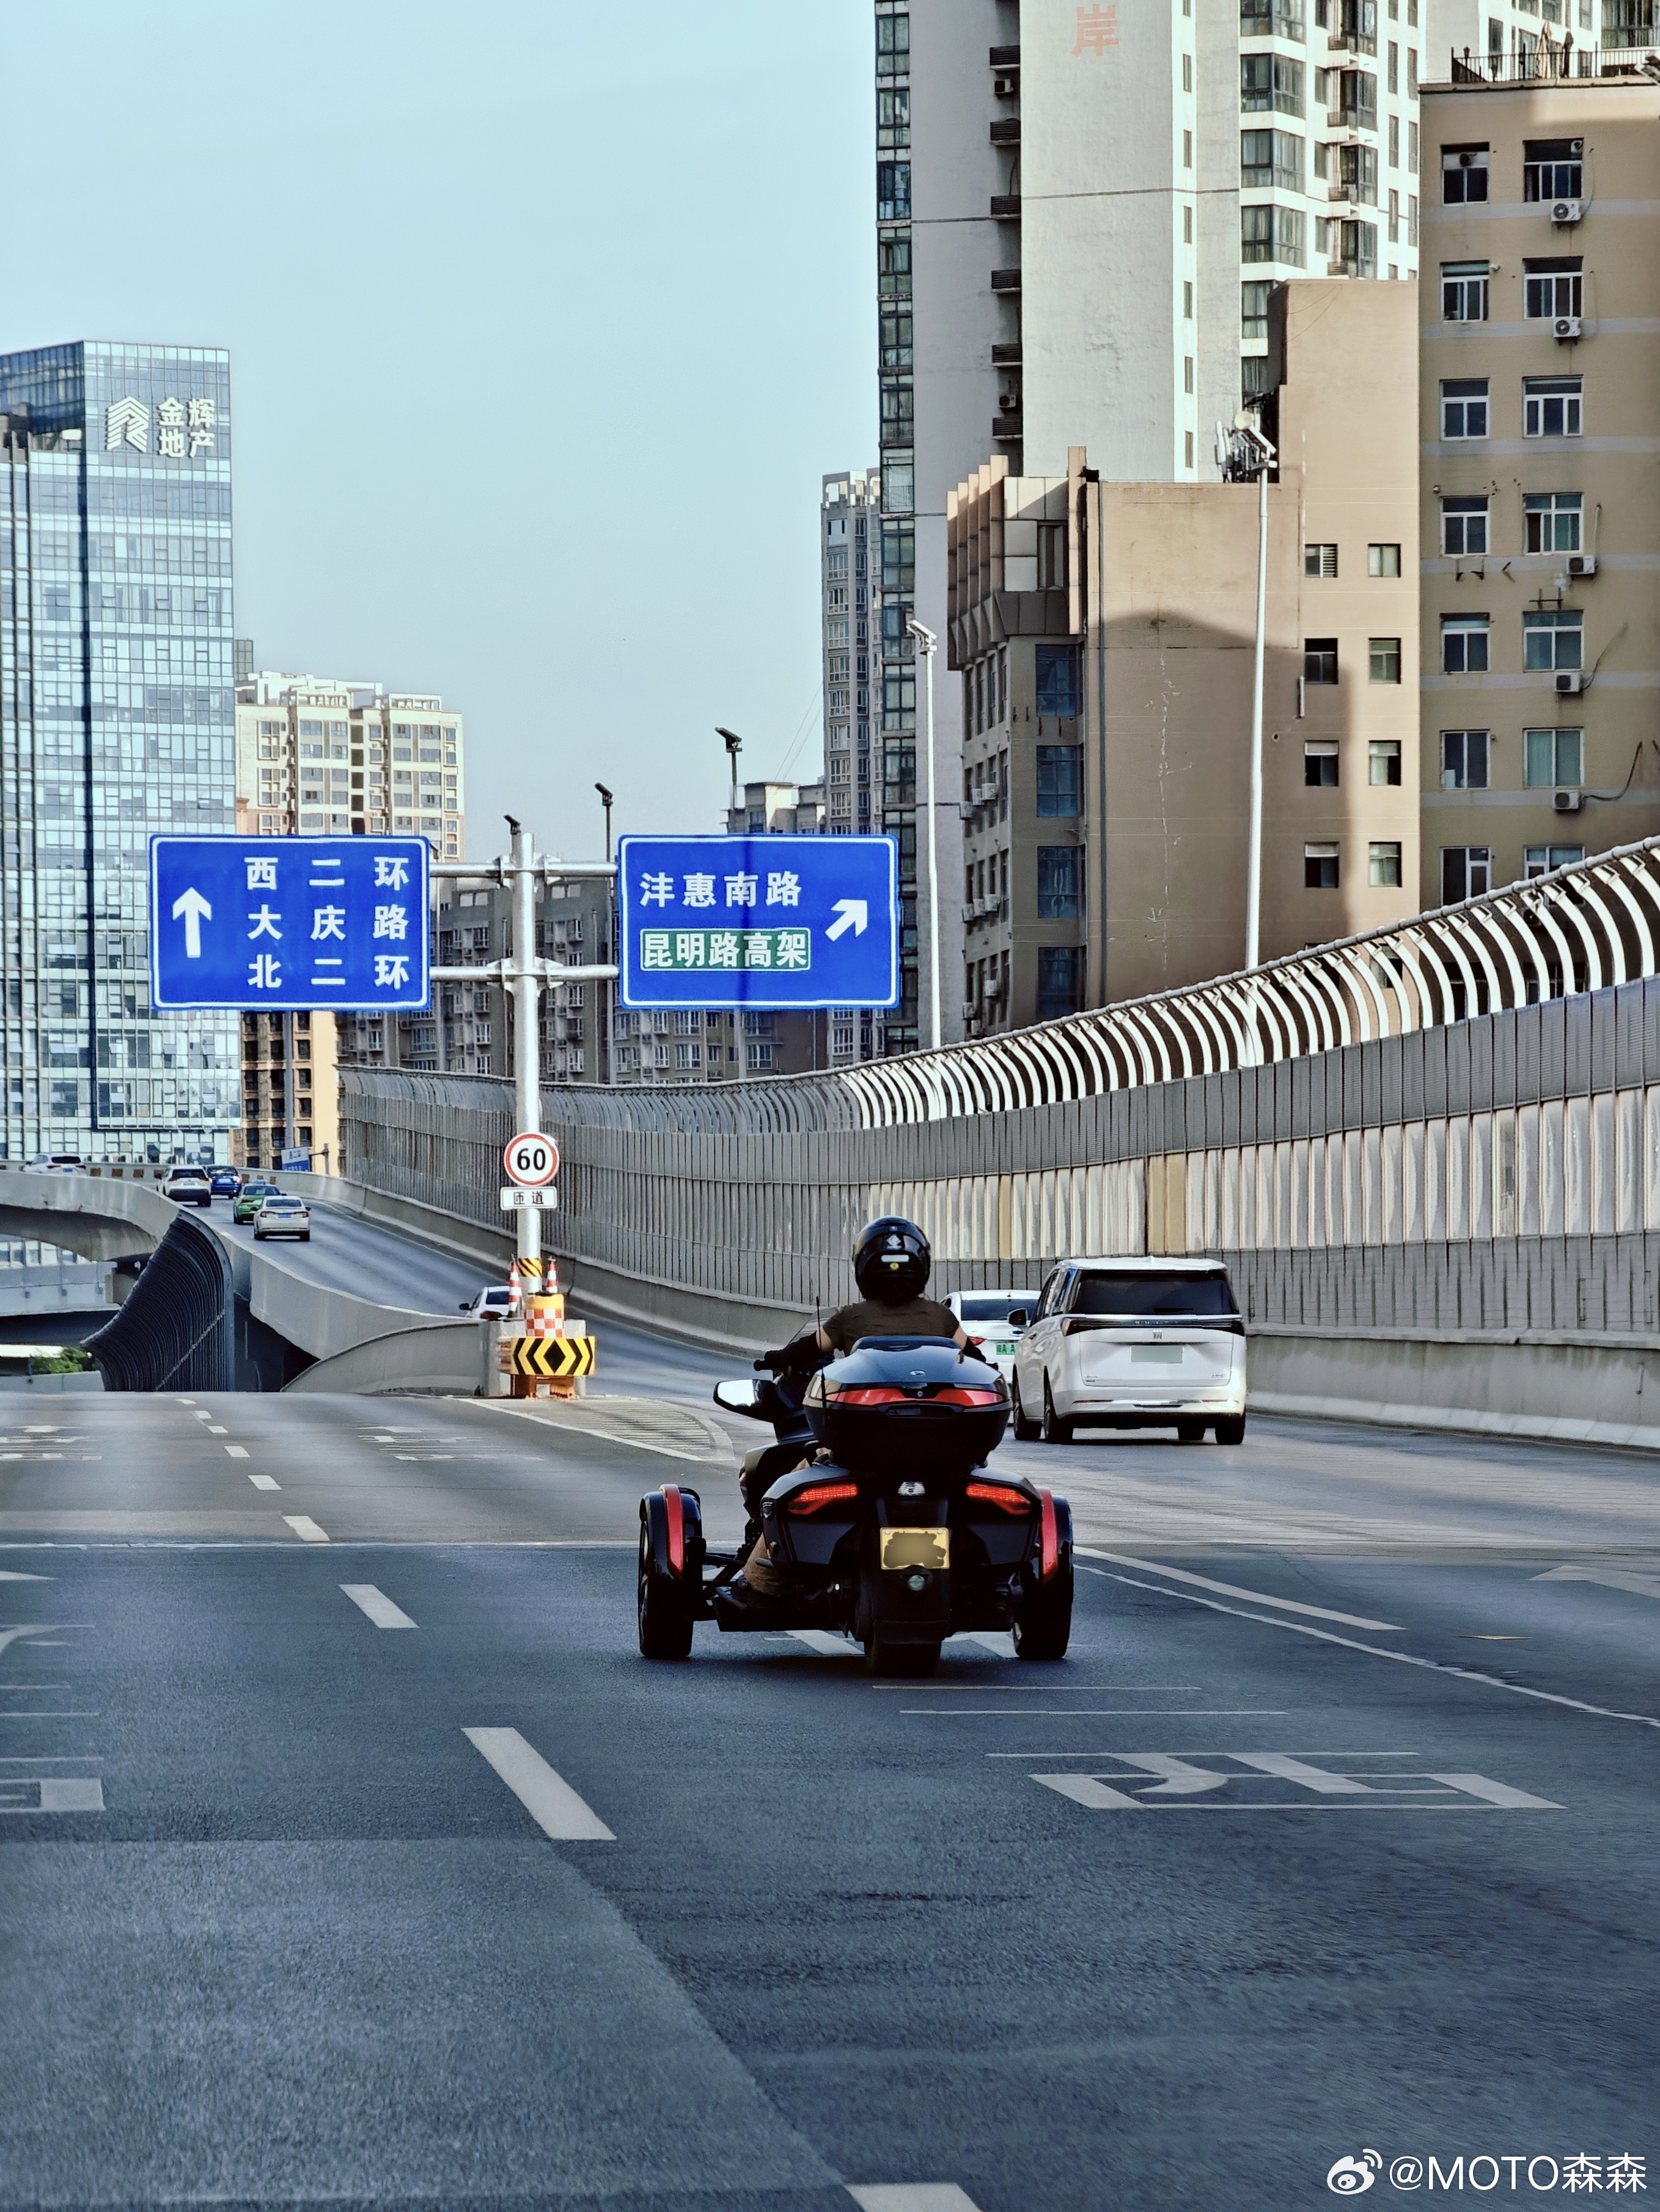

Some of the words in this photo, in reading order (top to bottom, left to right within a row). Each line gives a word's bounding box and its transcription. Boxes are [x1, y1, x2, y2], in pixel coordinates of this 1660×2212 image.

[1071, 4, 1120, 57] 岸
[158, 397, 215, 428] 金辉
[158, 428, 215, 458] 地产
[244, 856, 409, 892] 西二环
[639, 870, 802, 908] 沣惠南路
[247, 904, 409, 941] 大庆路
[644, 932, 807, 969] 昆明路高架
[247, 954, 409, 991] 北二环
[516, 1148, 546, 1171] 60
[513, 1190, 544, 1205] 匝道
